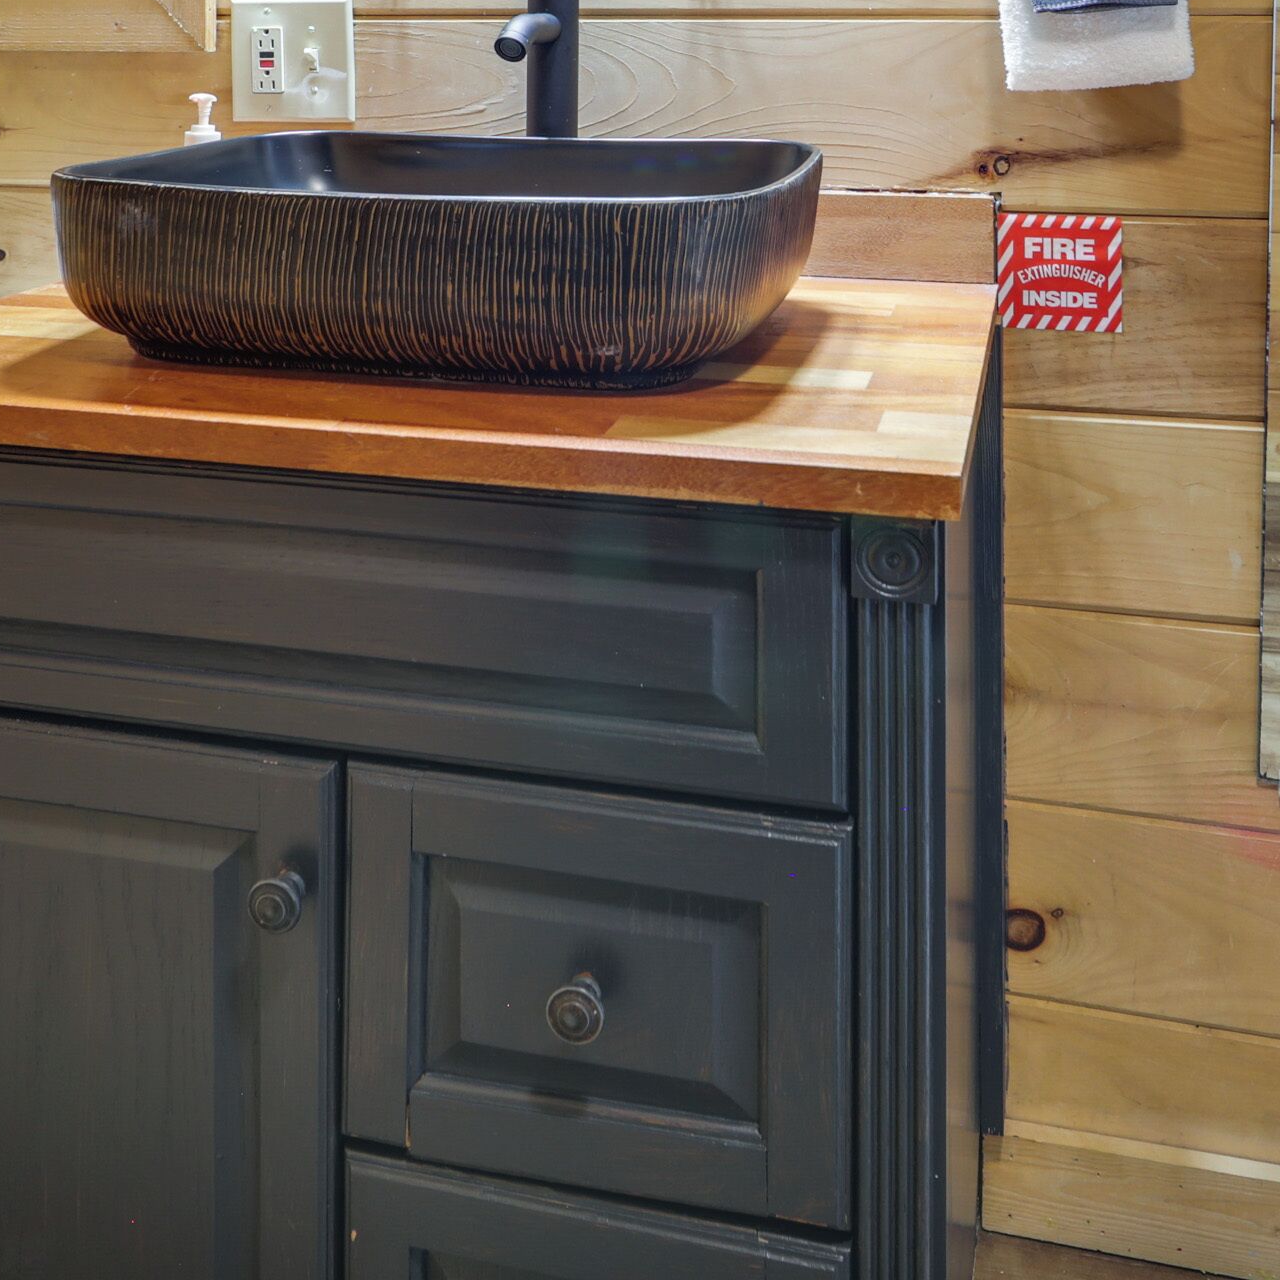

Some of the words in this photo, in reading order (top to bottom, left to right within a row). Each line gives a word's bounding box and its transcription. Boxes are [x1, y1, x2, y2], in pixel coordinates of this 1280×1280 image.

[1024, 236, 1096, 261] FIRE
[1017, 264, 1107, 288] EXTINGUISHER
[1022, 290, 1098, 308] INSIDE
